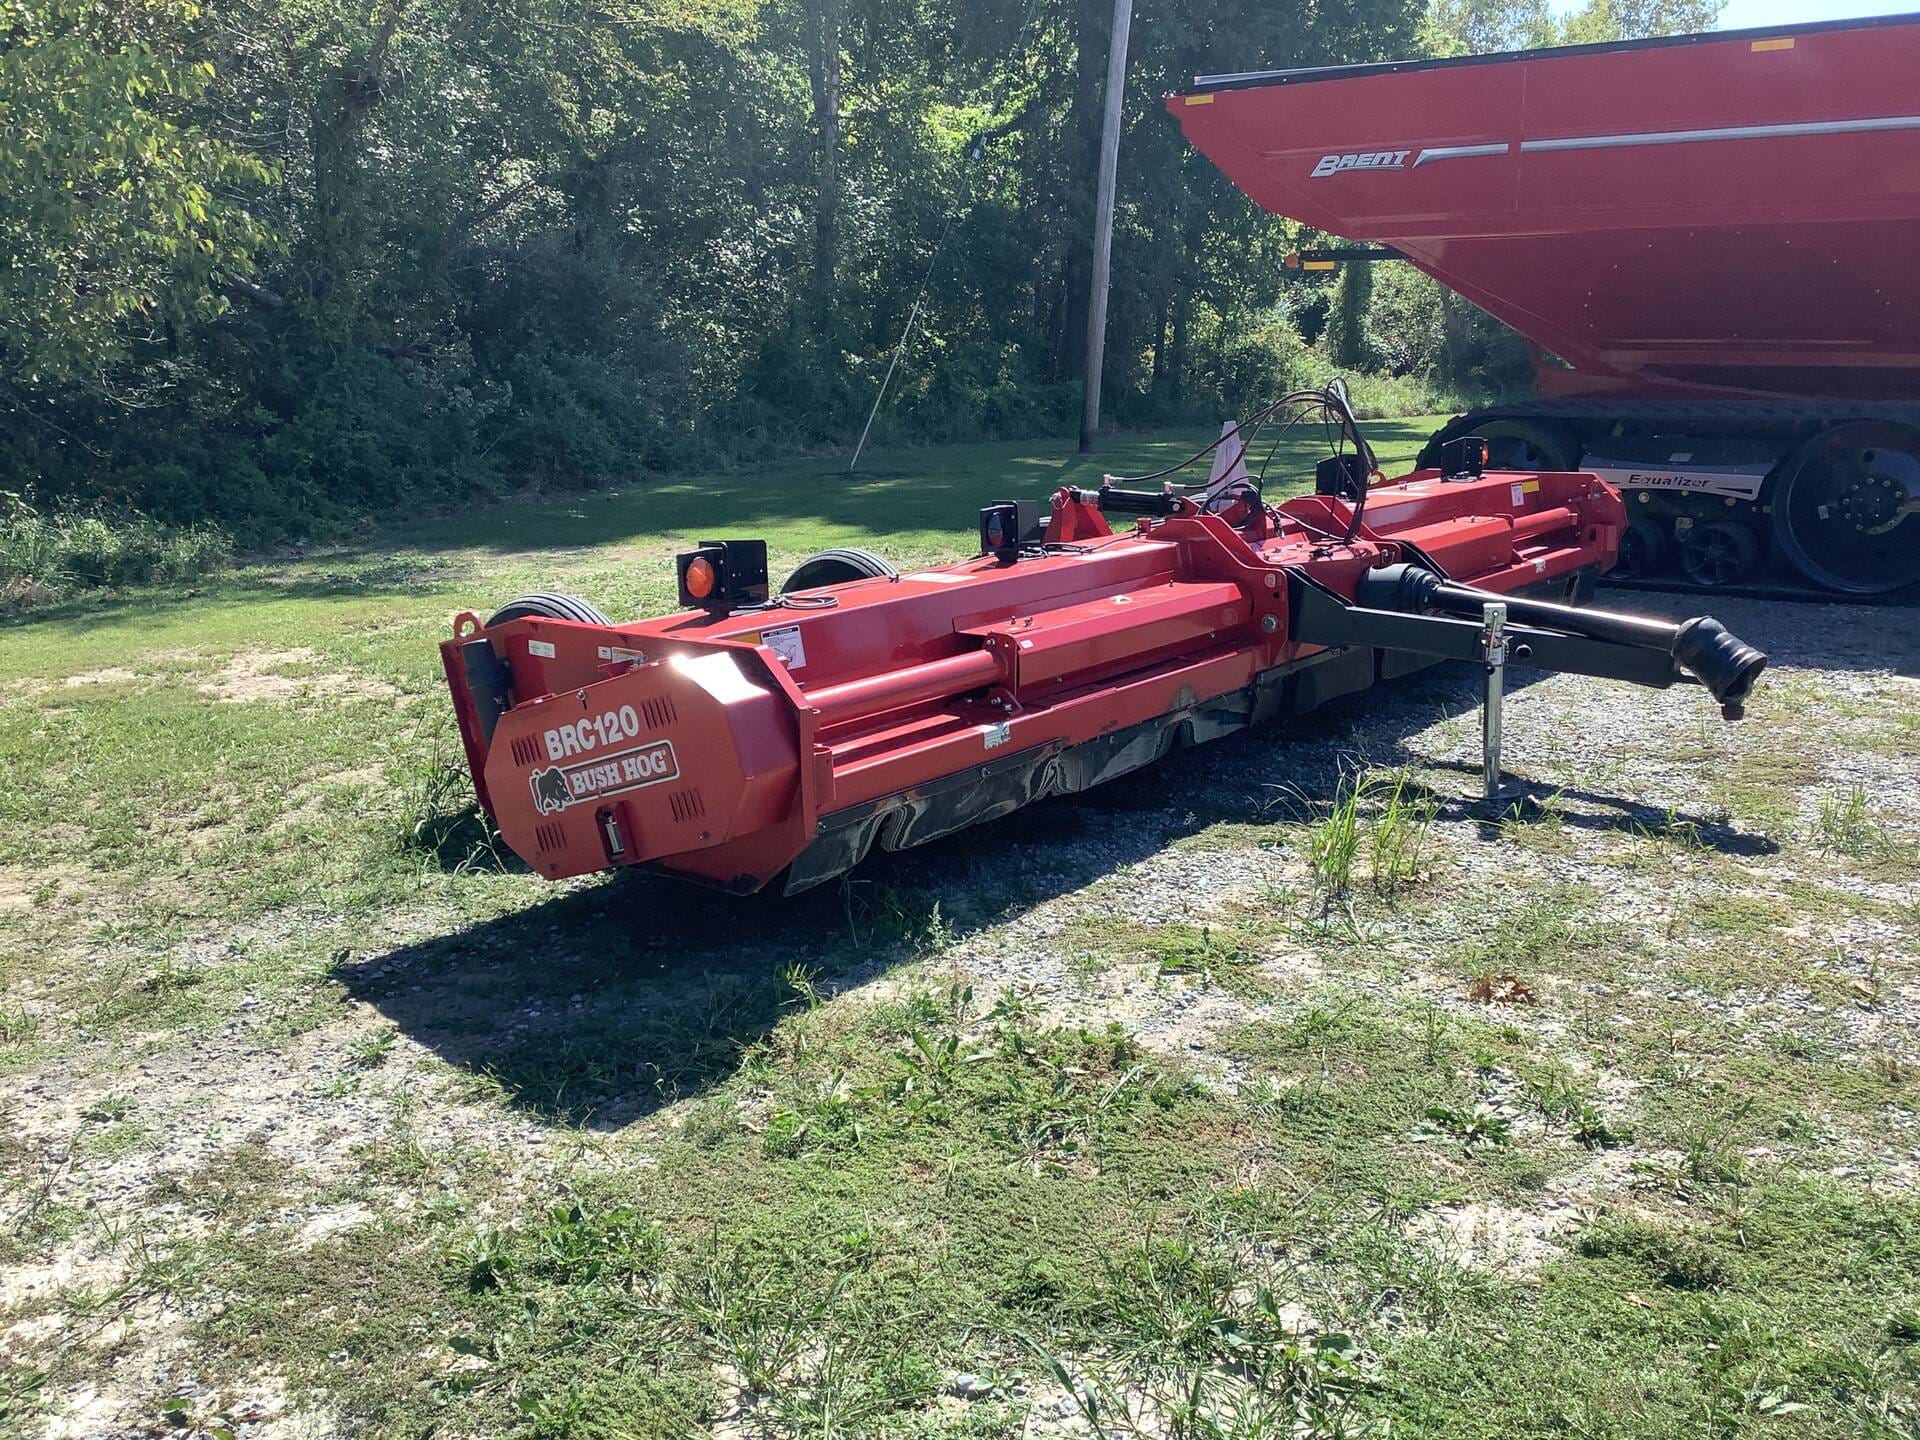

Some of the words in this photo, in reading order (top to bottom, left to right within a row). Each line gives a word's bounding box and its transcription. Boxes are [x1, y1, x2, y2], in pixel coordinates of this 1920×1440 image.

[1310, 150, 1412, 178] BRENT
[1628, 474, 1711, 488] Equalizer
[543, 705, 639, 761] BRC120
[570, 763, 622, 794] BUSH
[621, 751, 667, 781] HOG
